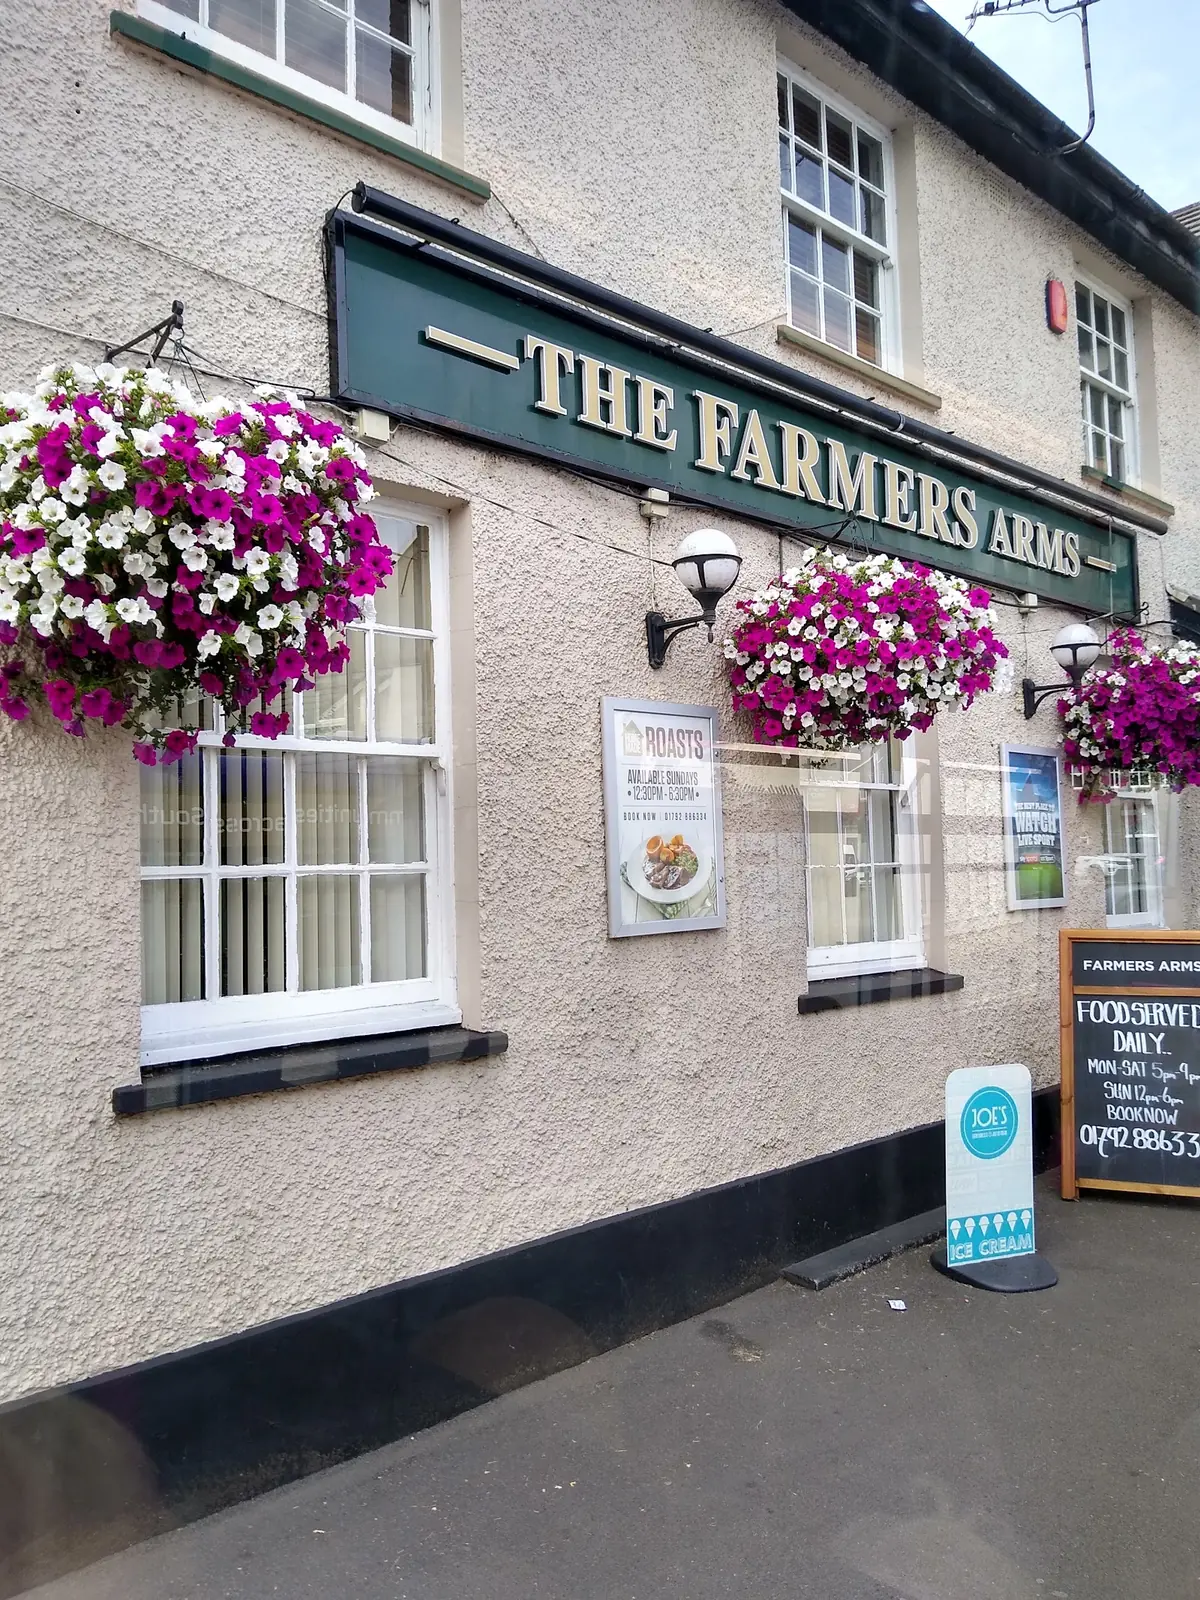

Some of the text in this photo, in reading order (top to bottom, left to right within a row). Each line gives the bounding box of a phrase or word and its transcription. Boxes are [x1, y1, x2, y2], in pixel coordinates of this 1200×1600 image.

[524, 334, 1081, 578] THE FARMERS ARMS
[645, 726, 704, 760] ROASTS
[627, 769, 699, 786] AVAILABLE SUNDAYS
[632, 785, 664, 801] 12:30PM
[668, 786, 695, 801] 6:30PM
[623, 811, 640, 821] BOOK
[643, 812, 657, 821] NOW
[664, 812, 682, 821] 01792
[1015, 811, 1057, 834] WATCH
[1017, 834, 1055, 847] LIVE SPORT
[1083, 960, 1200, 973] FARMERS ARMS
[1077, 1000, 1131, 1024] FOOD
[1088, 1058, 1147, 1077] MON-SAT
[1103, 1080, 1184, 1107] SUN 12pm-6pm
[971, 1105, 1008, 1128] JOE'S
[1106, 1104, 1179, 1126] BOOK NOW
[1079, 1124, 1132, 1158] 01792
[949, 1233, 1032, 1260] ICE CREAM
